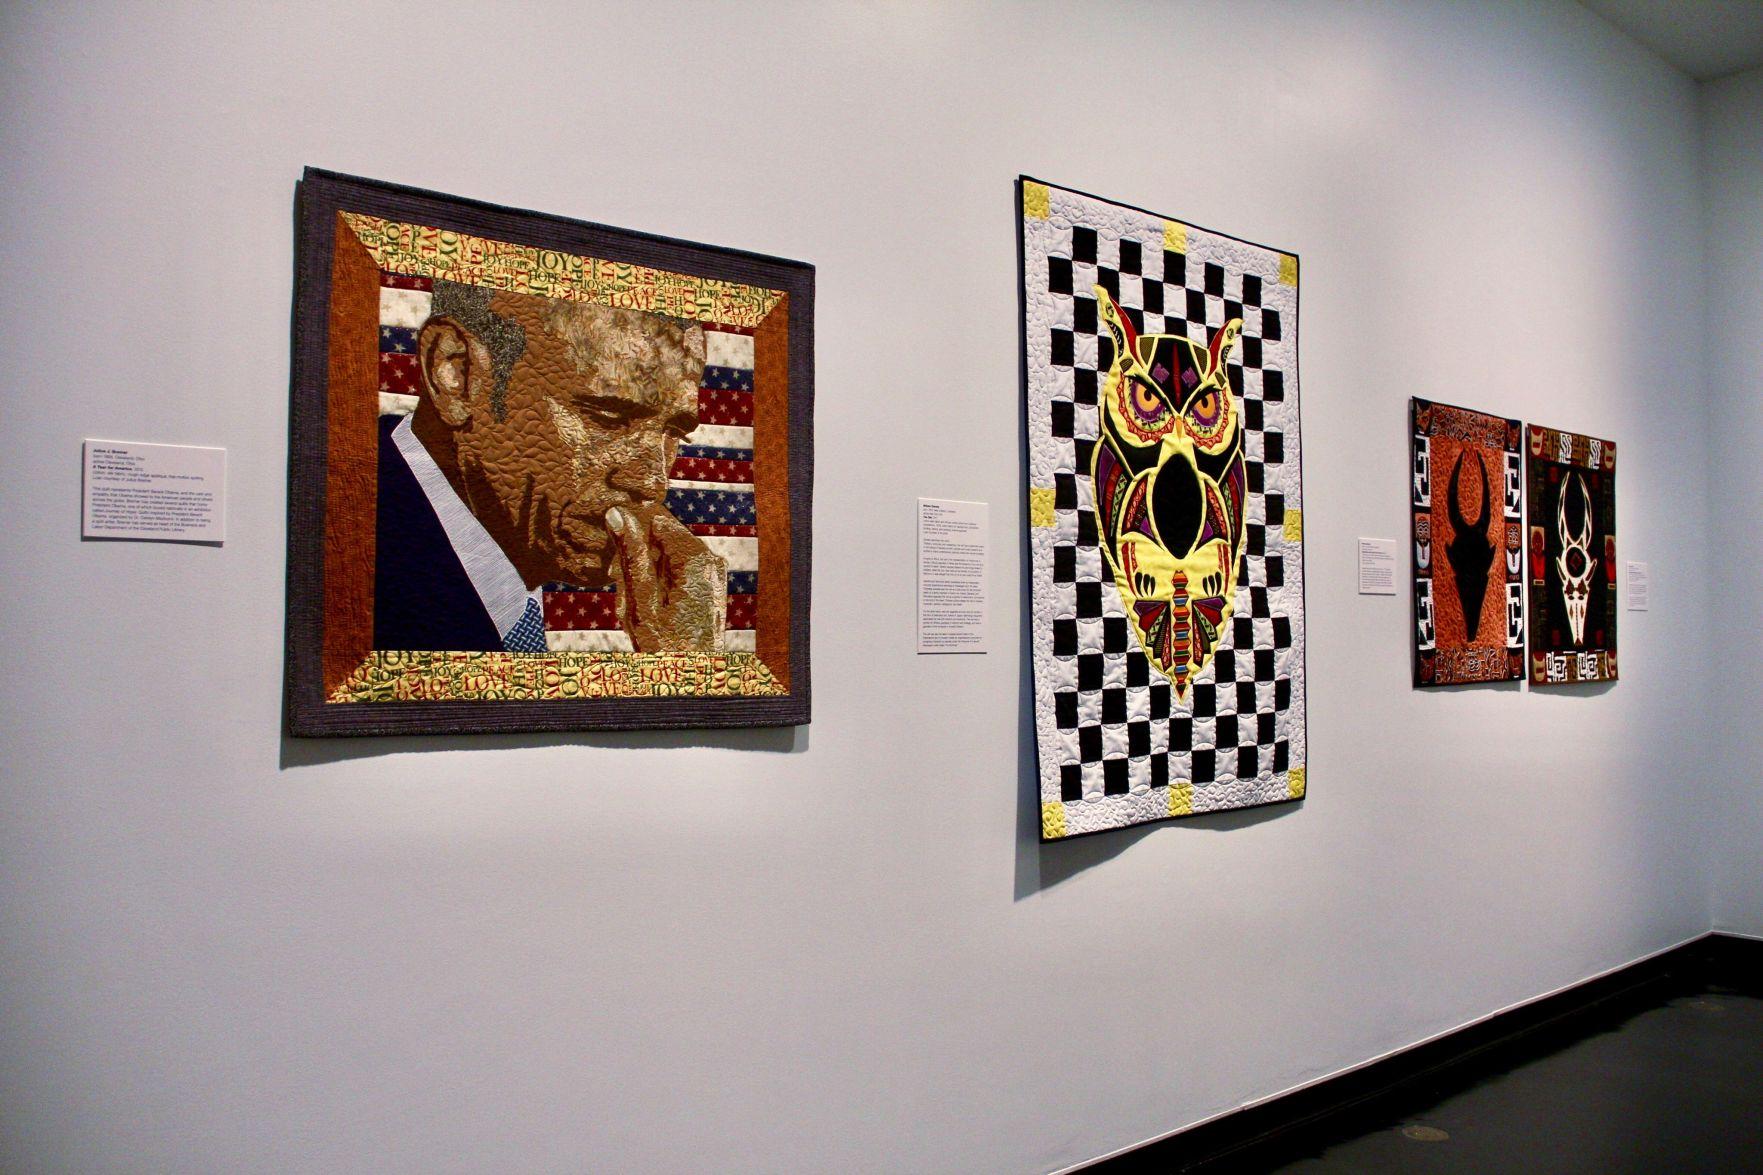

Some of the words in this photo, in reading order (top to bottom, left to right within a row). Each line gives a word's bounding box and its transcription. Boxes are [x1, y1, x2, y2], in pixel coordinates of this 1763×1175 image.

[535, 249, 572, 271] JOY
[529, 269, 562, 284] HOPE
[609, 292, 656, 311] LOVE
[694, 287, 721, 300] HOPE
[560, 656, 590, 669] HOPE
[463, 675, 514, 692] LOVE
[640, 666, 681, 684] LOVE
